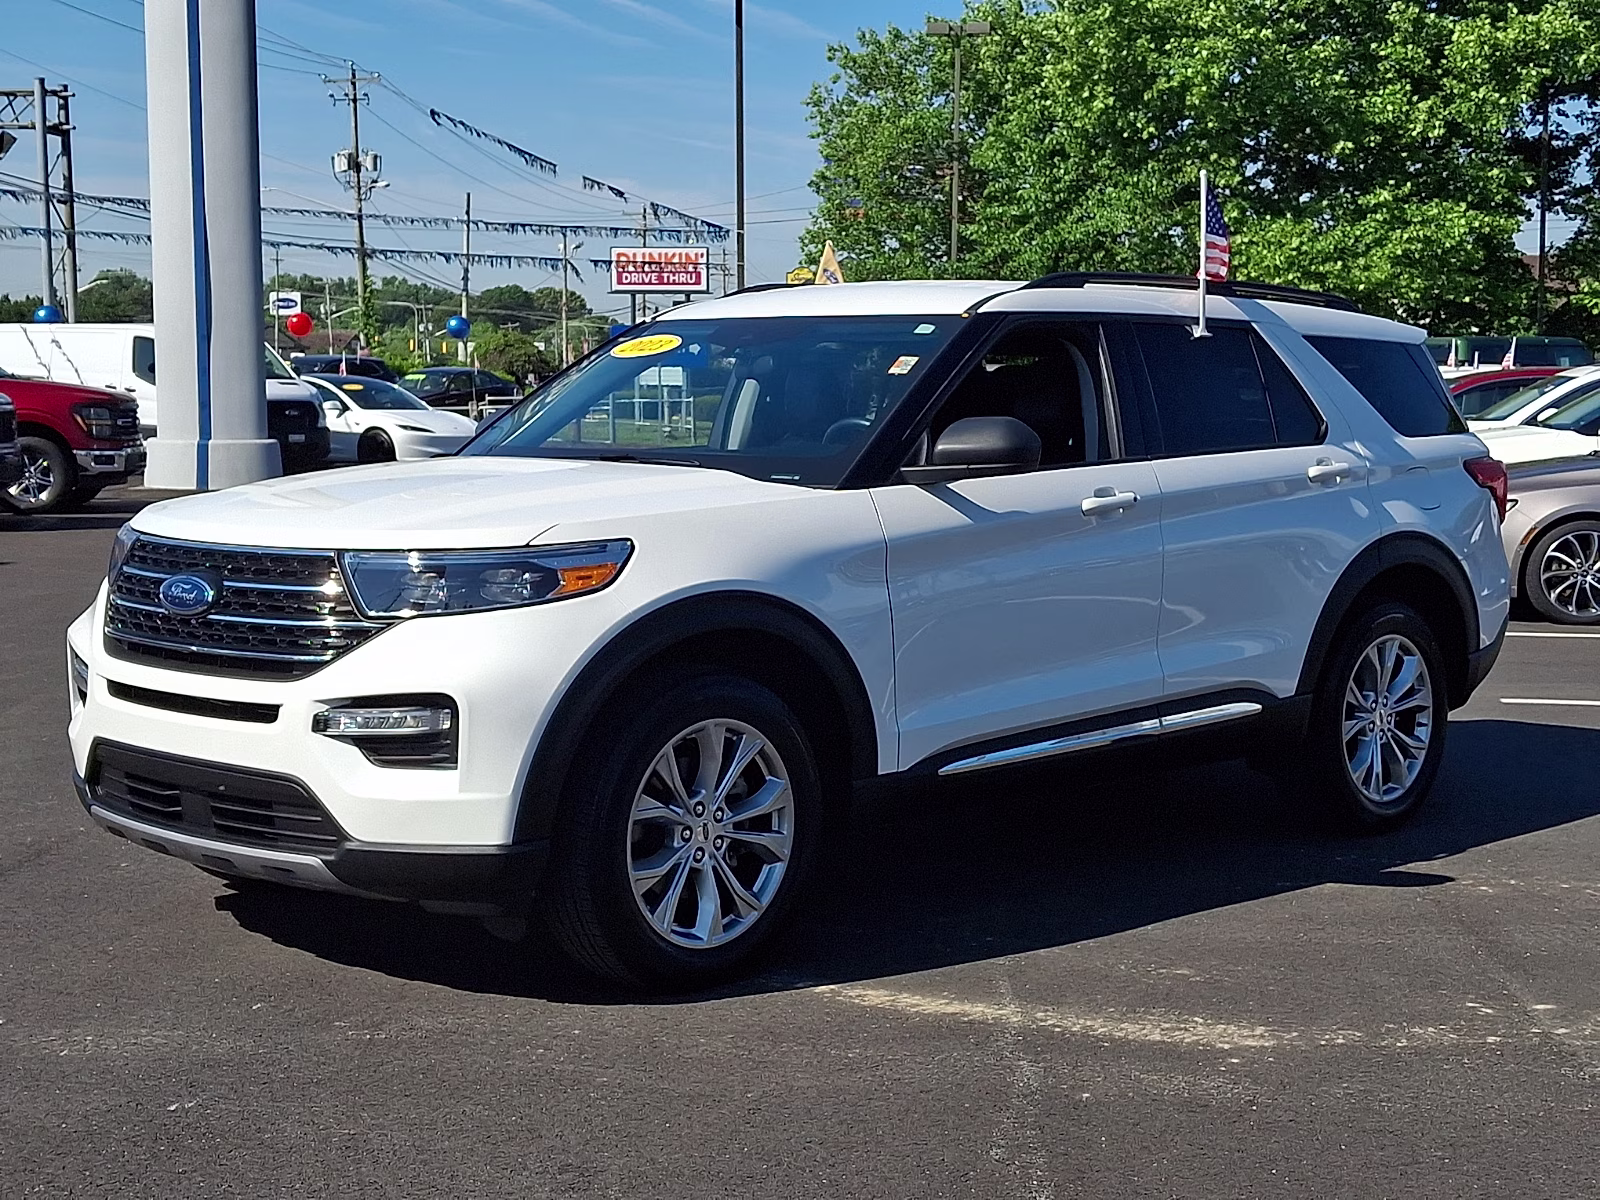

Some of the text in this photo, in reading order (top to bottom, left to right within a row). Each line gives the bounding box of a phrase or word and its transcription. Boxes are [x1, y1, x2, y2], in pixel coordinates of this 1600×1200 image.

[616, 252, 705, 271] DUNKIN'
[622, 273, 696, 284] DRIVE THRU
[169, 582, 198, 603] Ford
